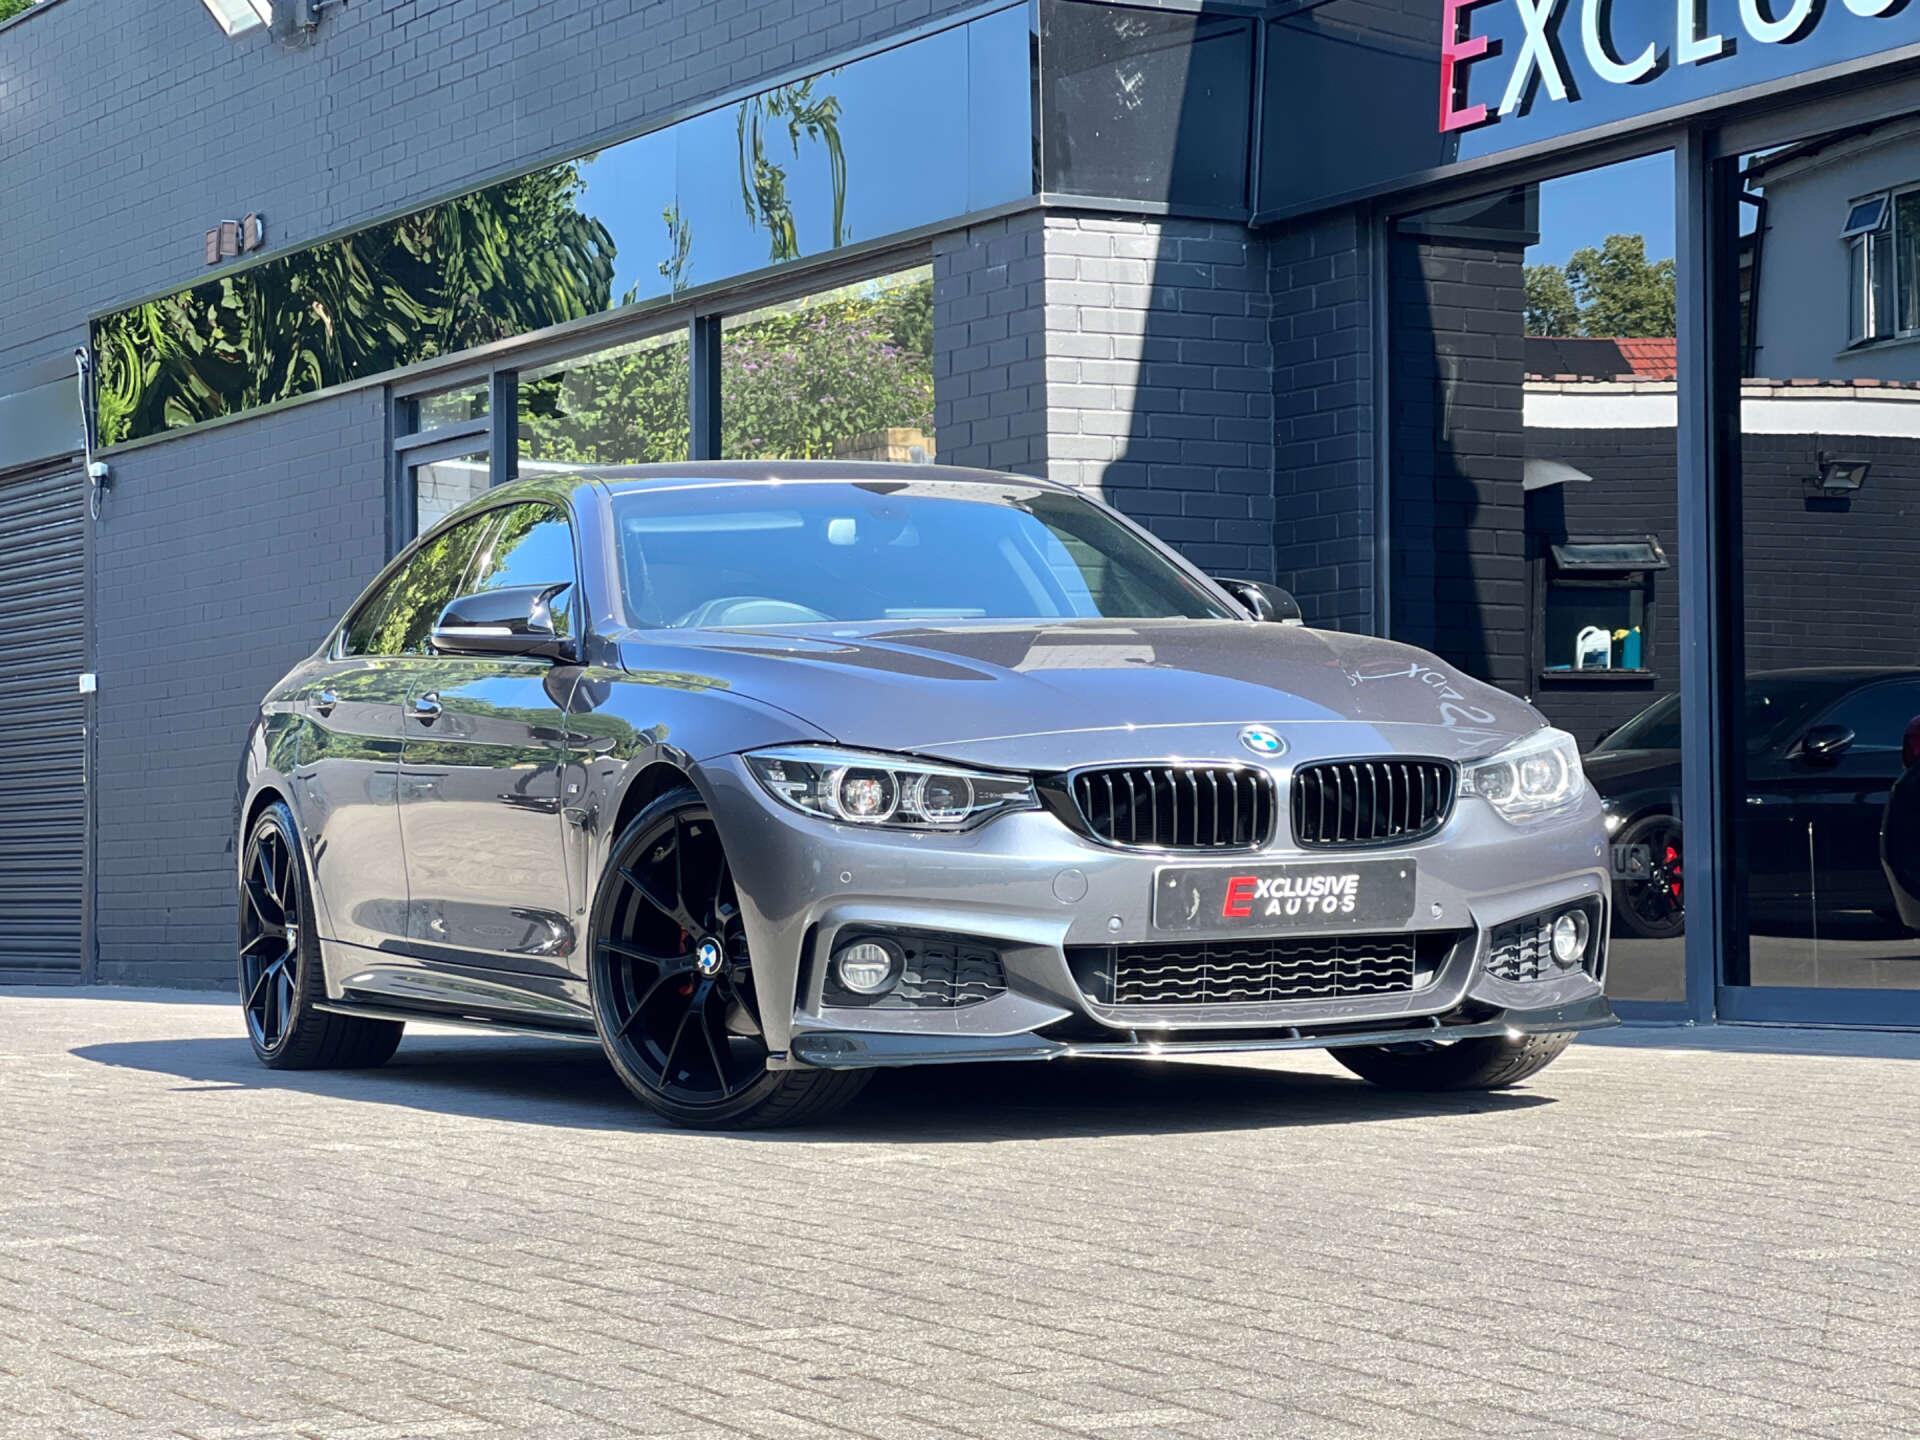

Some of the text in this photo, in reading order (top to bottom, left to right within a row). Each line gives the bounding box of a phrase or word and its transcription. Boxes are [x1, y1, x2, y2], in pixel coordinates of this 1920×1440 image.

[1439, 0, 1895, 132] EXCL
[1222, 874, 1360, 918] EXCLUSIVE
[1264, 895, 1356, 917] AUTOS
